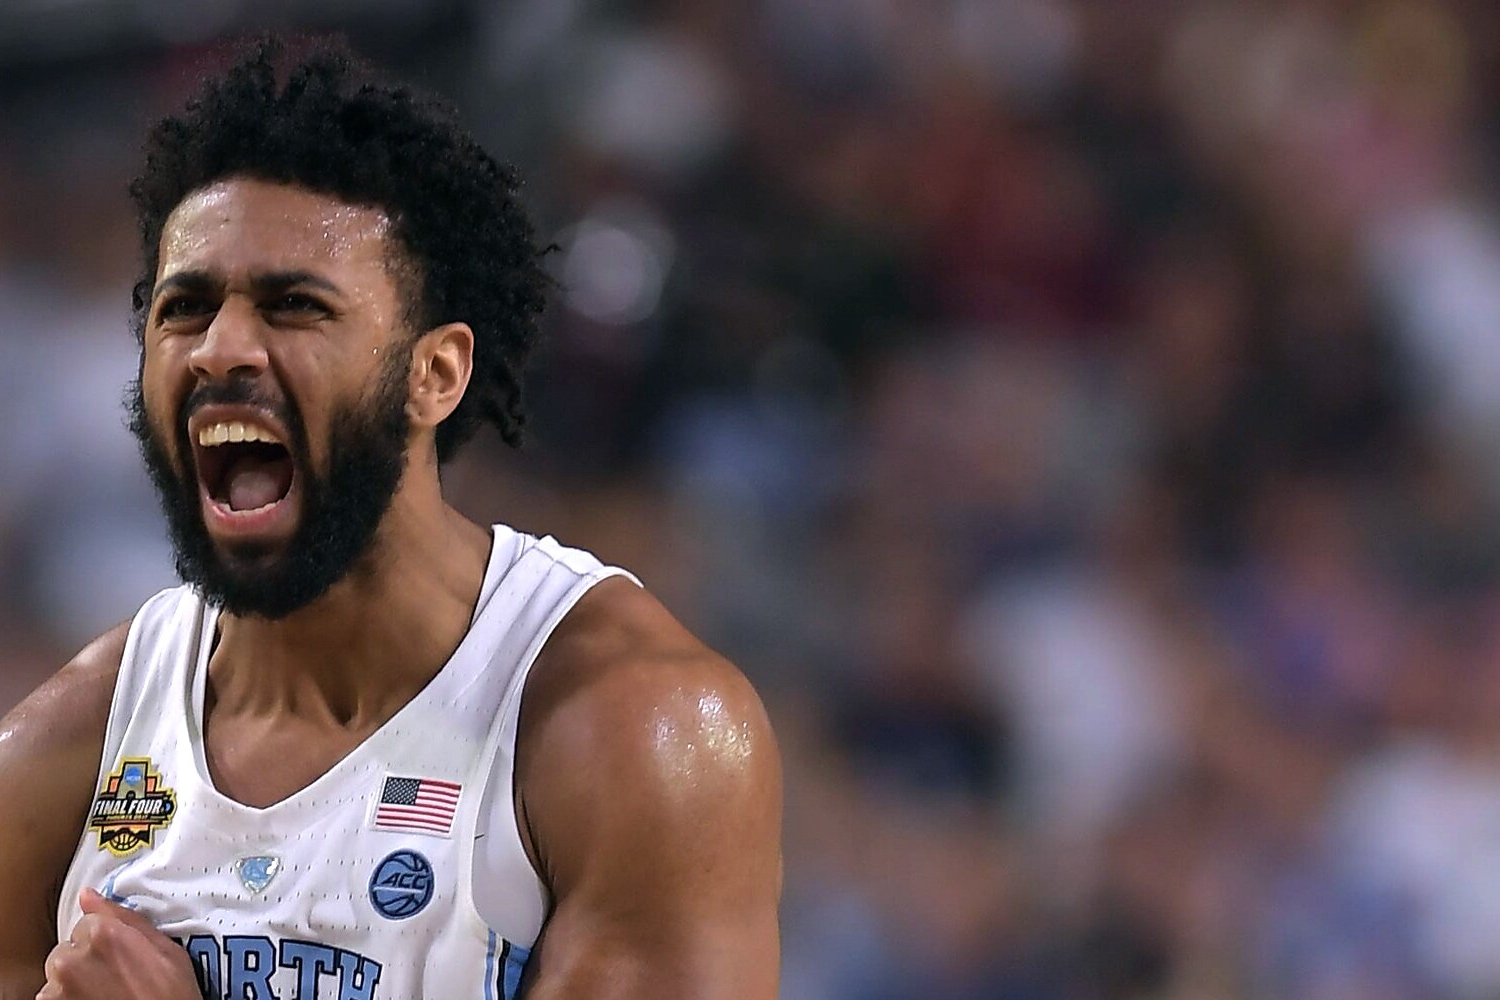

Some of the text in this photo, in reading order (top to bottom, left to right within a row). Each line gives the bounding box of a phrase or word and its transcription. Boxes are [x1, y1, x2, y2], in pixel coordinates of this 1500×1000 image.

[93, 798, 163, 817] FINAL FOUR
[377, 872, 429, 891] ACC
